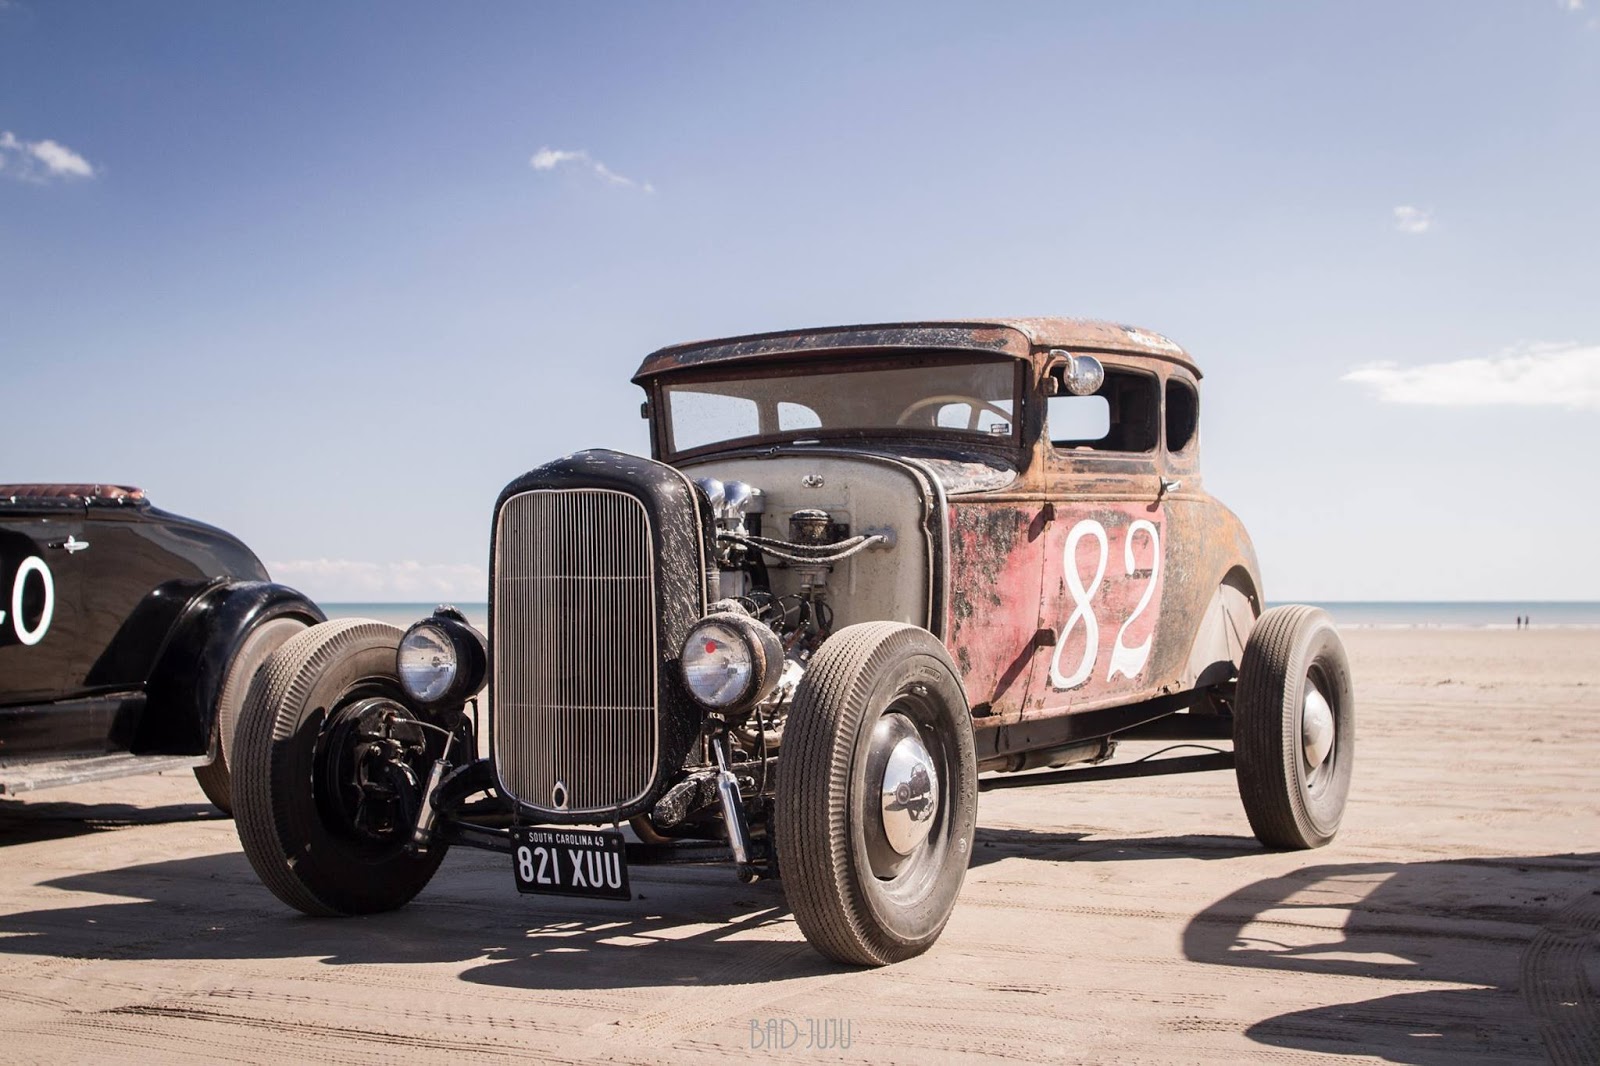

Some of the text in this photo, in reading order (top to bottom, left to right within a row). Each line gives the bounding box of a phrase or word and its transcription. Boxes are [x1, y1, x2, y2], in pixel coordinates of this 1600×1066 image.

[0, 556, 54, 645] 0
[1050, 519, 1160, 689] 82
[517, 846, 622, 889] 821 XUU
[528, 832, 604, 847] SOUTH CAROLINA 49
